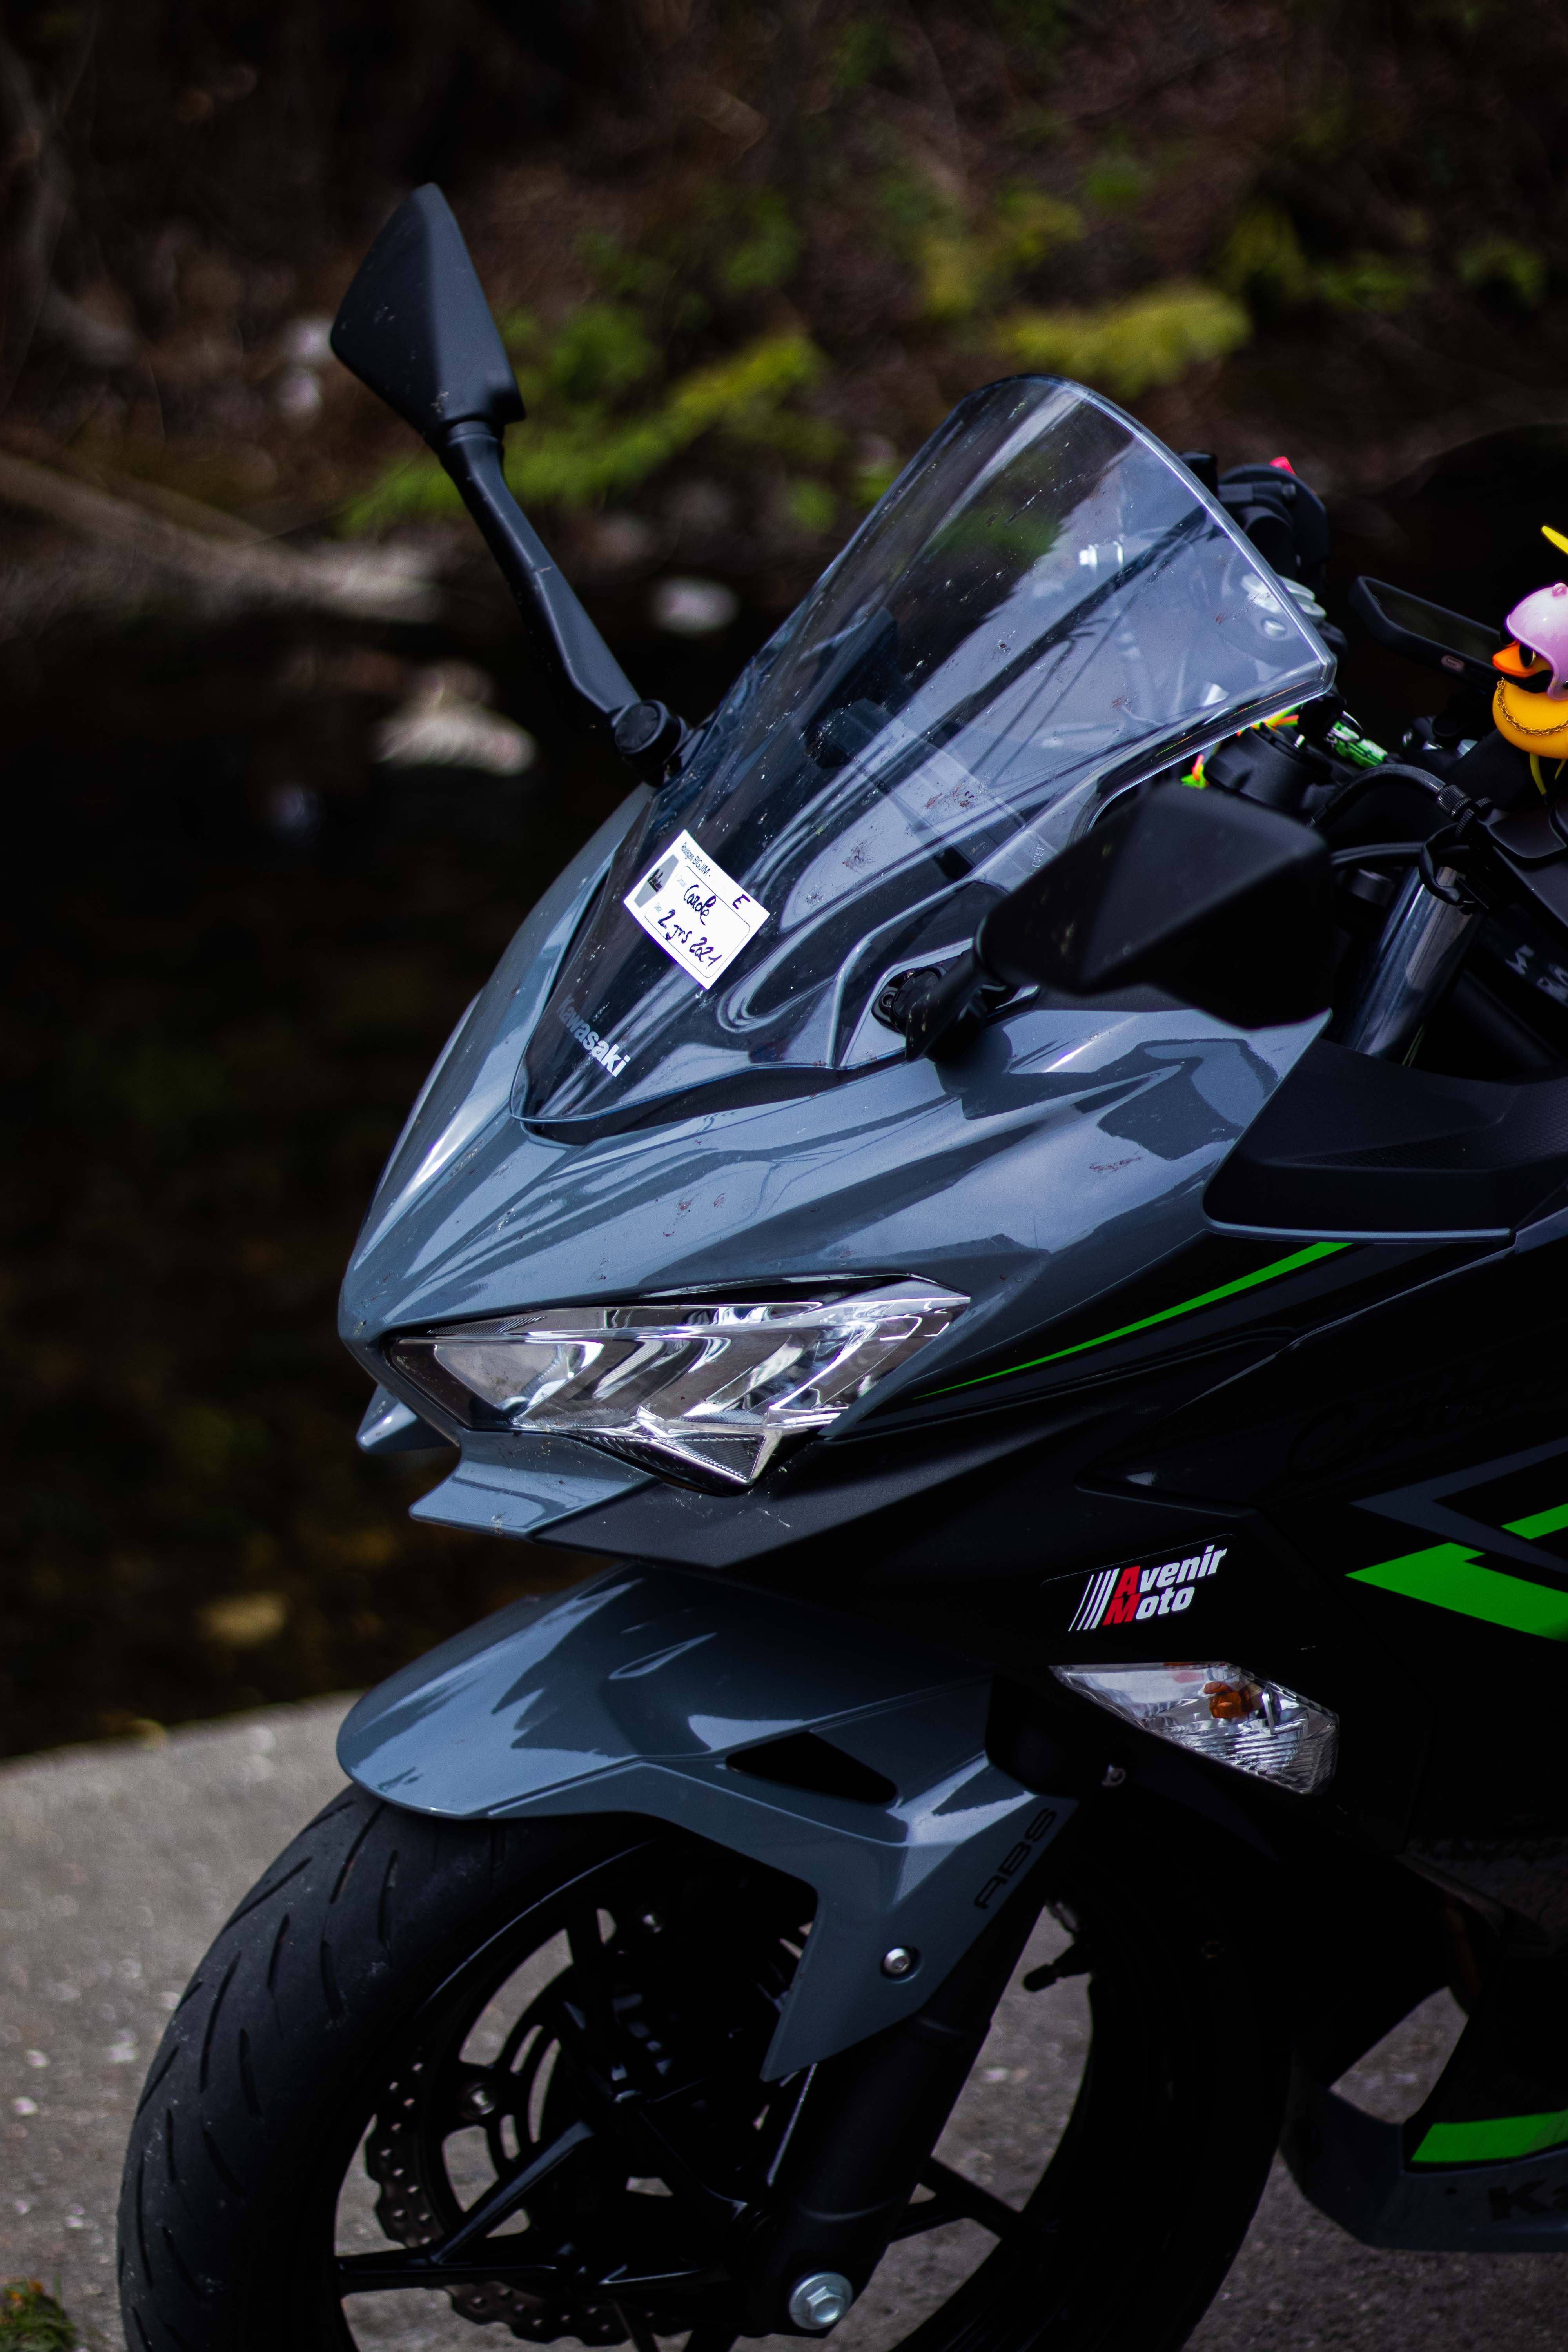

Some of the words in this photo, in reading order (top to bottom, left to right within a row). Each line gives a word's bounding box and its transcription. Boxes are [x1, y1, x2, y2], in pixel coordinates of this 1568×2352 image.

[692, 856, 710, 876] BIGJIM
[732, 893, 751, 910] E
[1113, 1544, 1227, 1598] Avenir
[1102, 1586, 1195, 1626] Moto
[973, 1808, 1057, 1909] ABS
